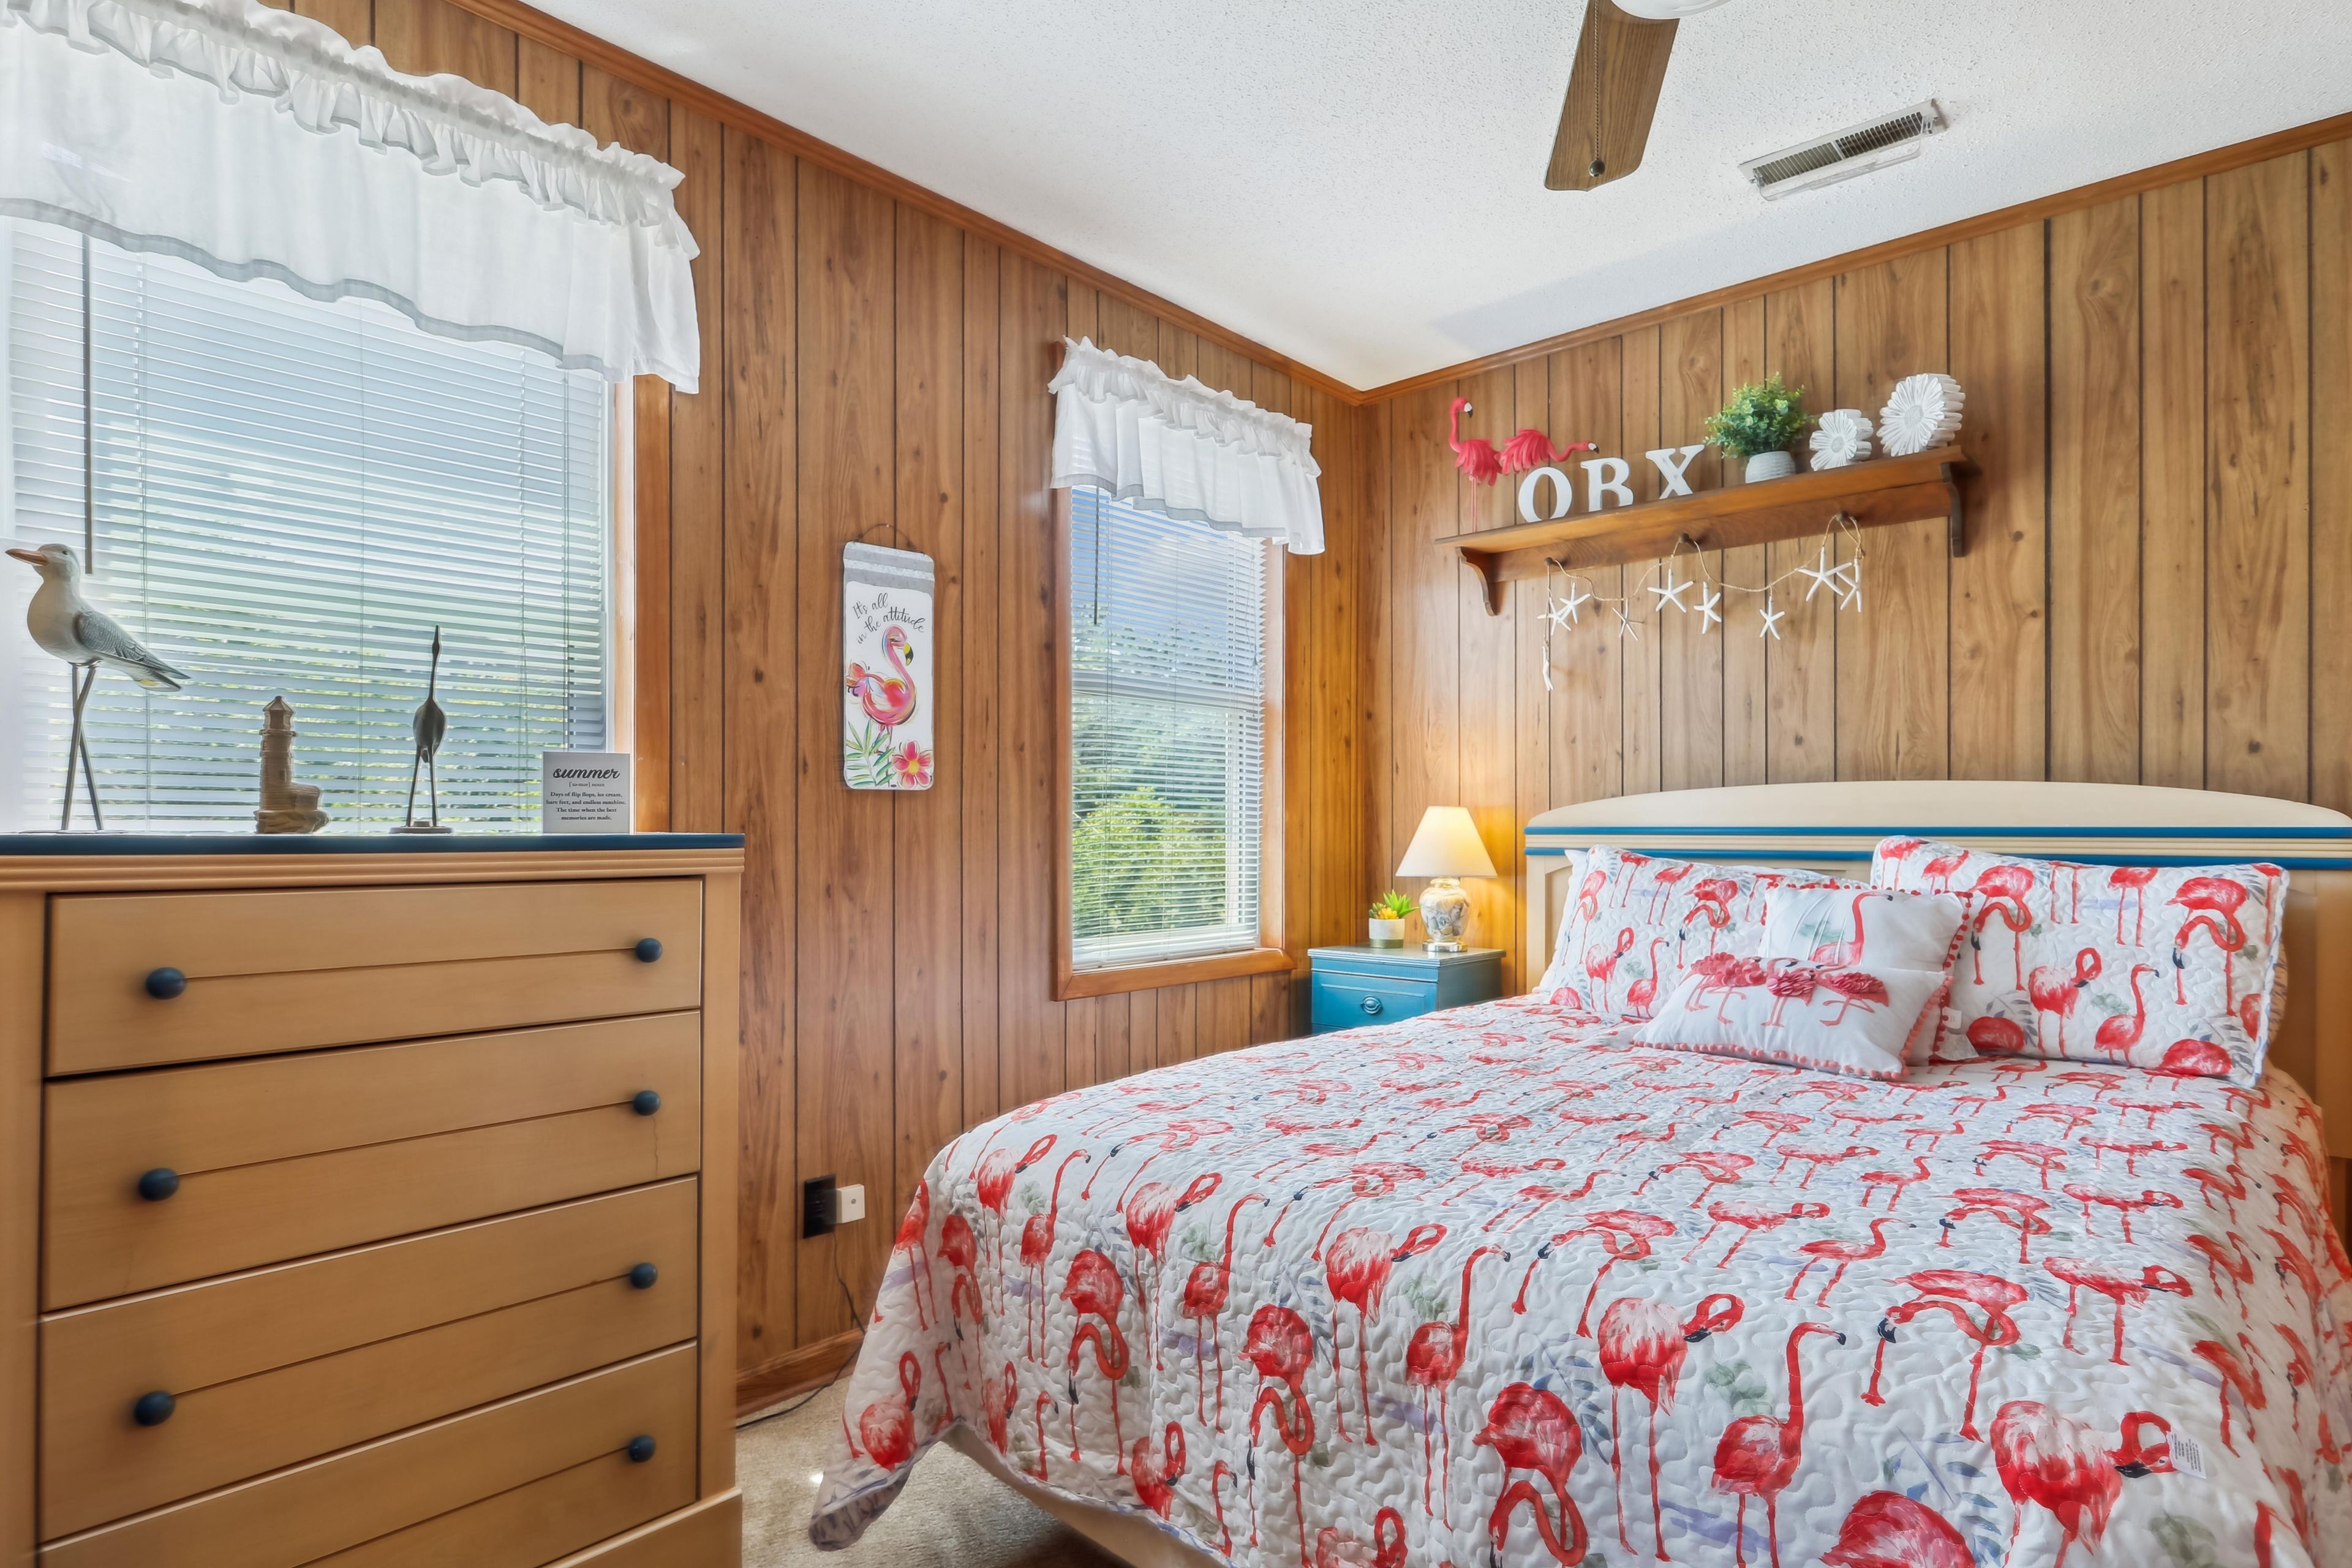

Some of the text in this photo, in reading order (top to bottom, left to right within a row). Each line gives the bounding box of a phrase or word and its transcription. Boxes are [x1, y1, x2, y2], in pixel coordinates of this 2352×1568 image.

[853, 593, 888, 619] It's all
[857, 606, 925, 644] in the attitude
[553, 768, 620, 778] summer
